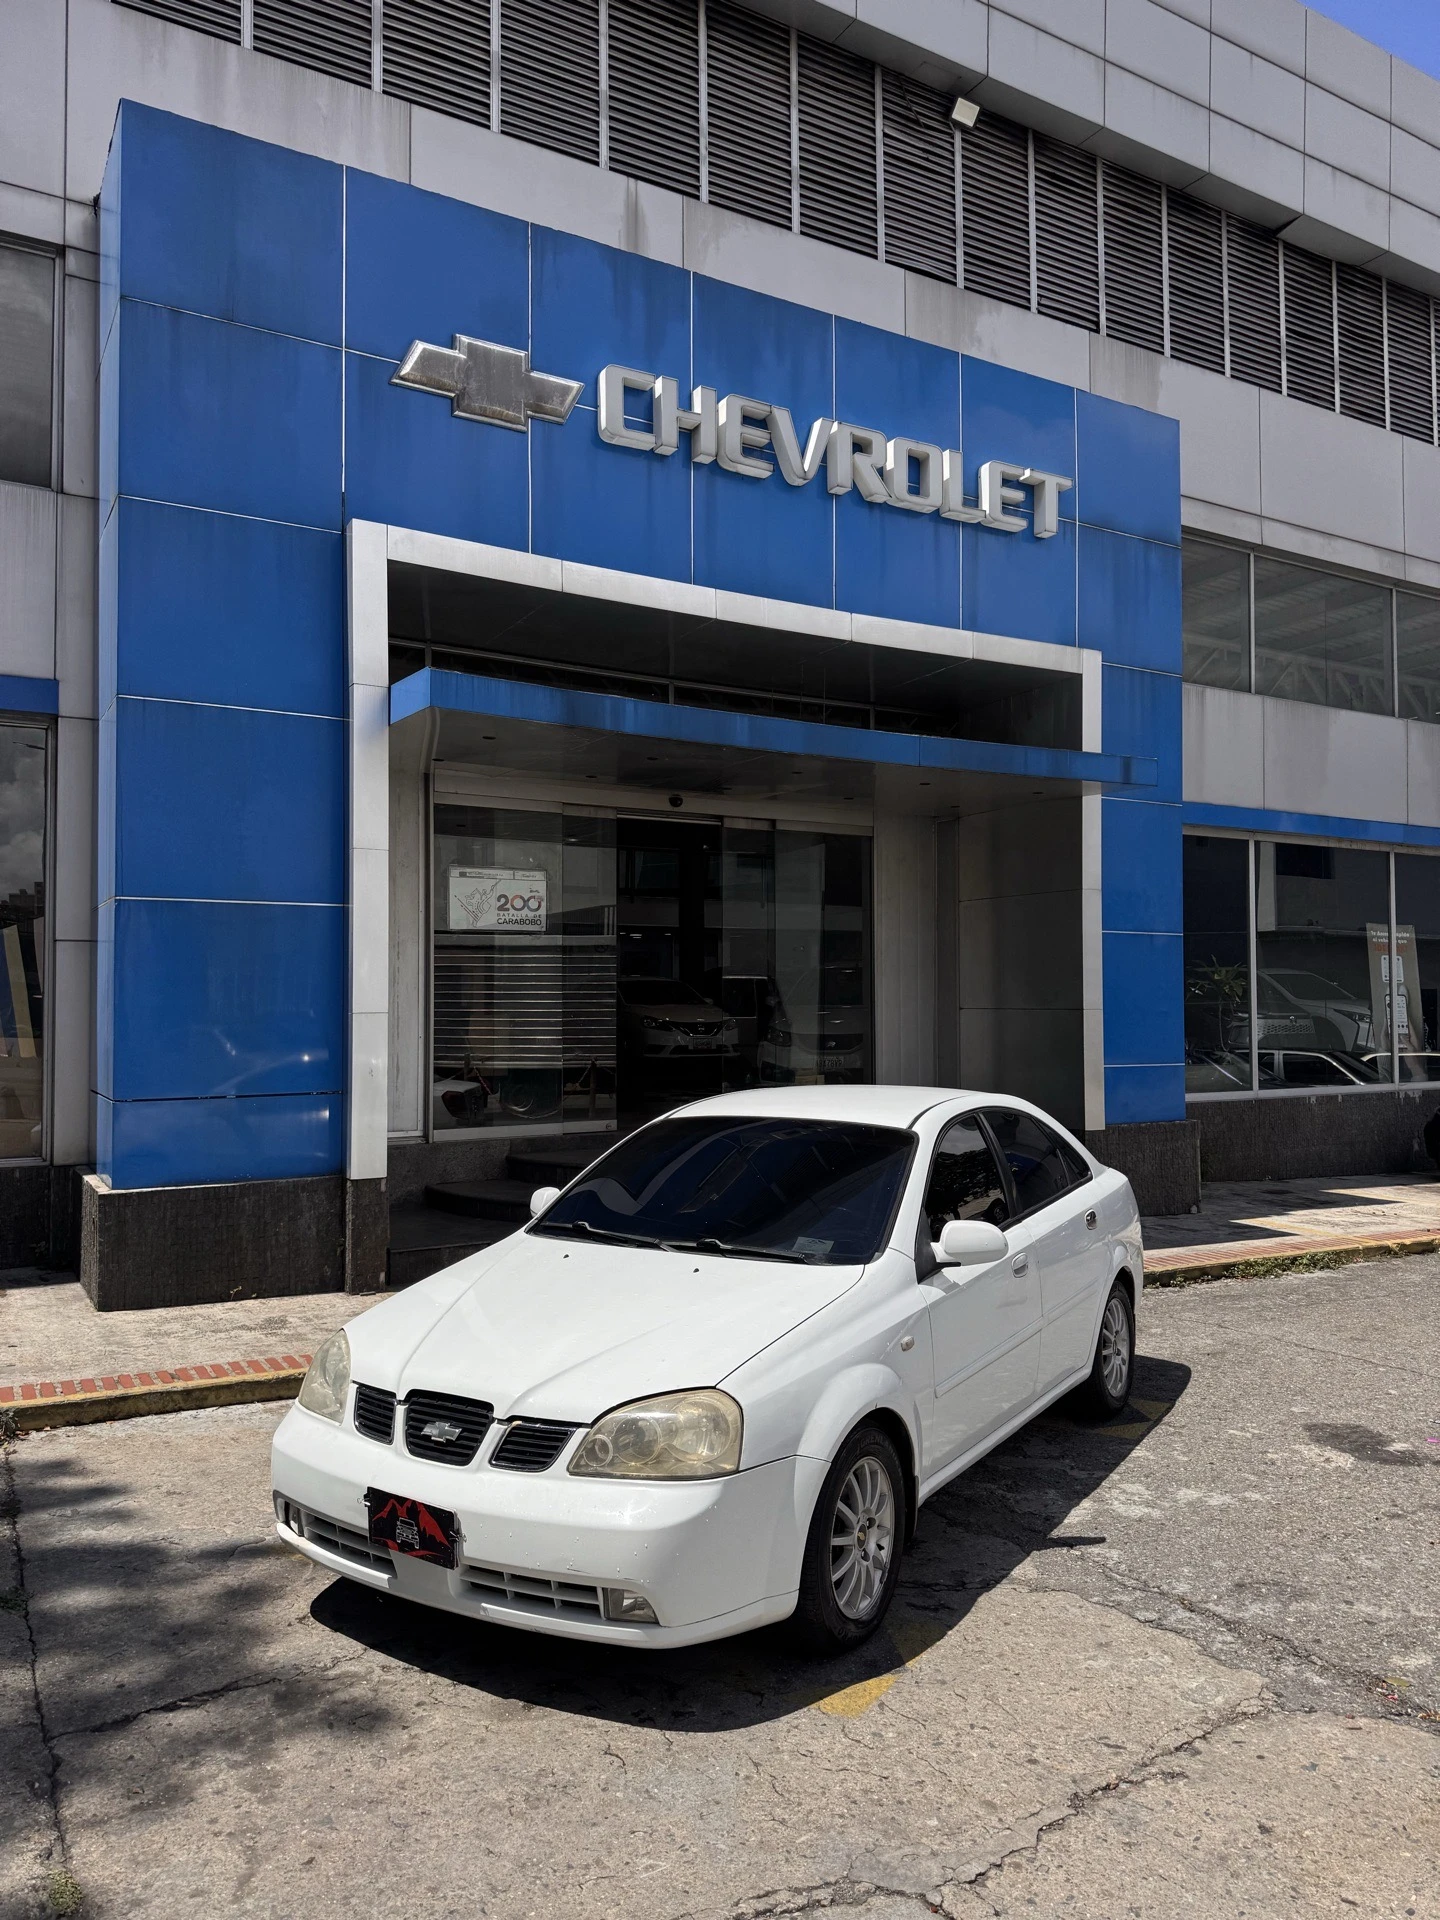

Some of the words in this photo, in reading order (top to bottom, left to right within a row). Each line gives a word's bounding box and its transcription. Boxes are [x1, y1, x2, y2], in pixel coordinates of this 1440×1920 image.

[597, 364, 1073, 539] CHEVROLET
[497, 894, 542, 912] 200
[497, 918, 542, 926] CARABOBO
